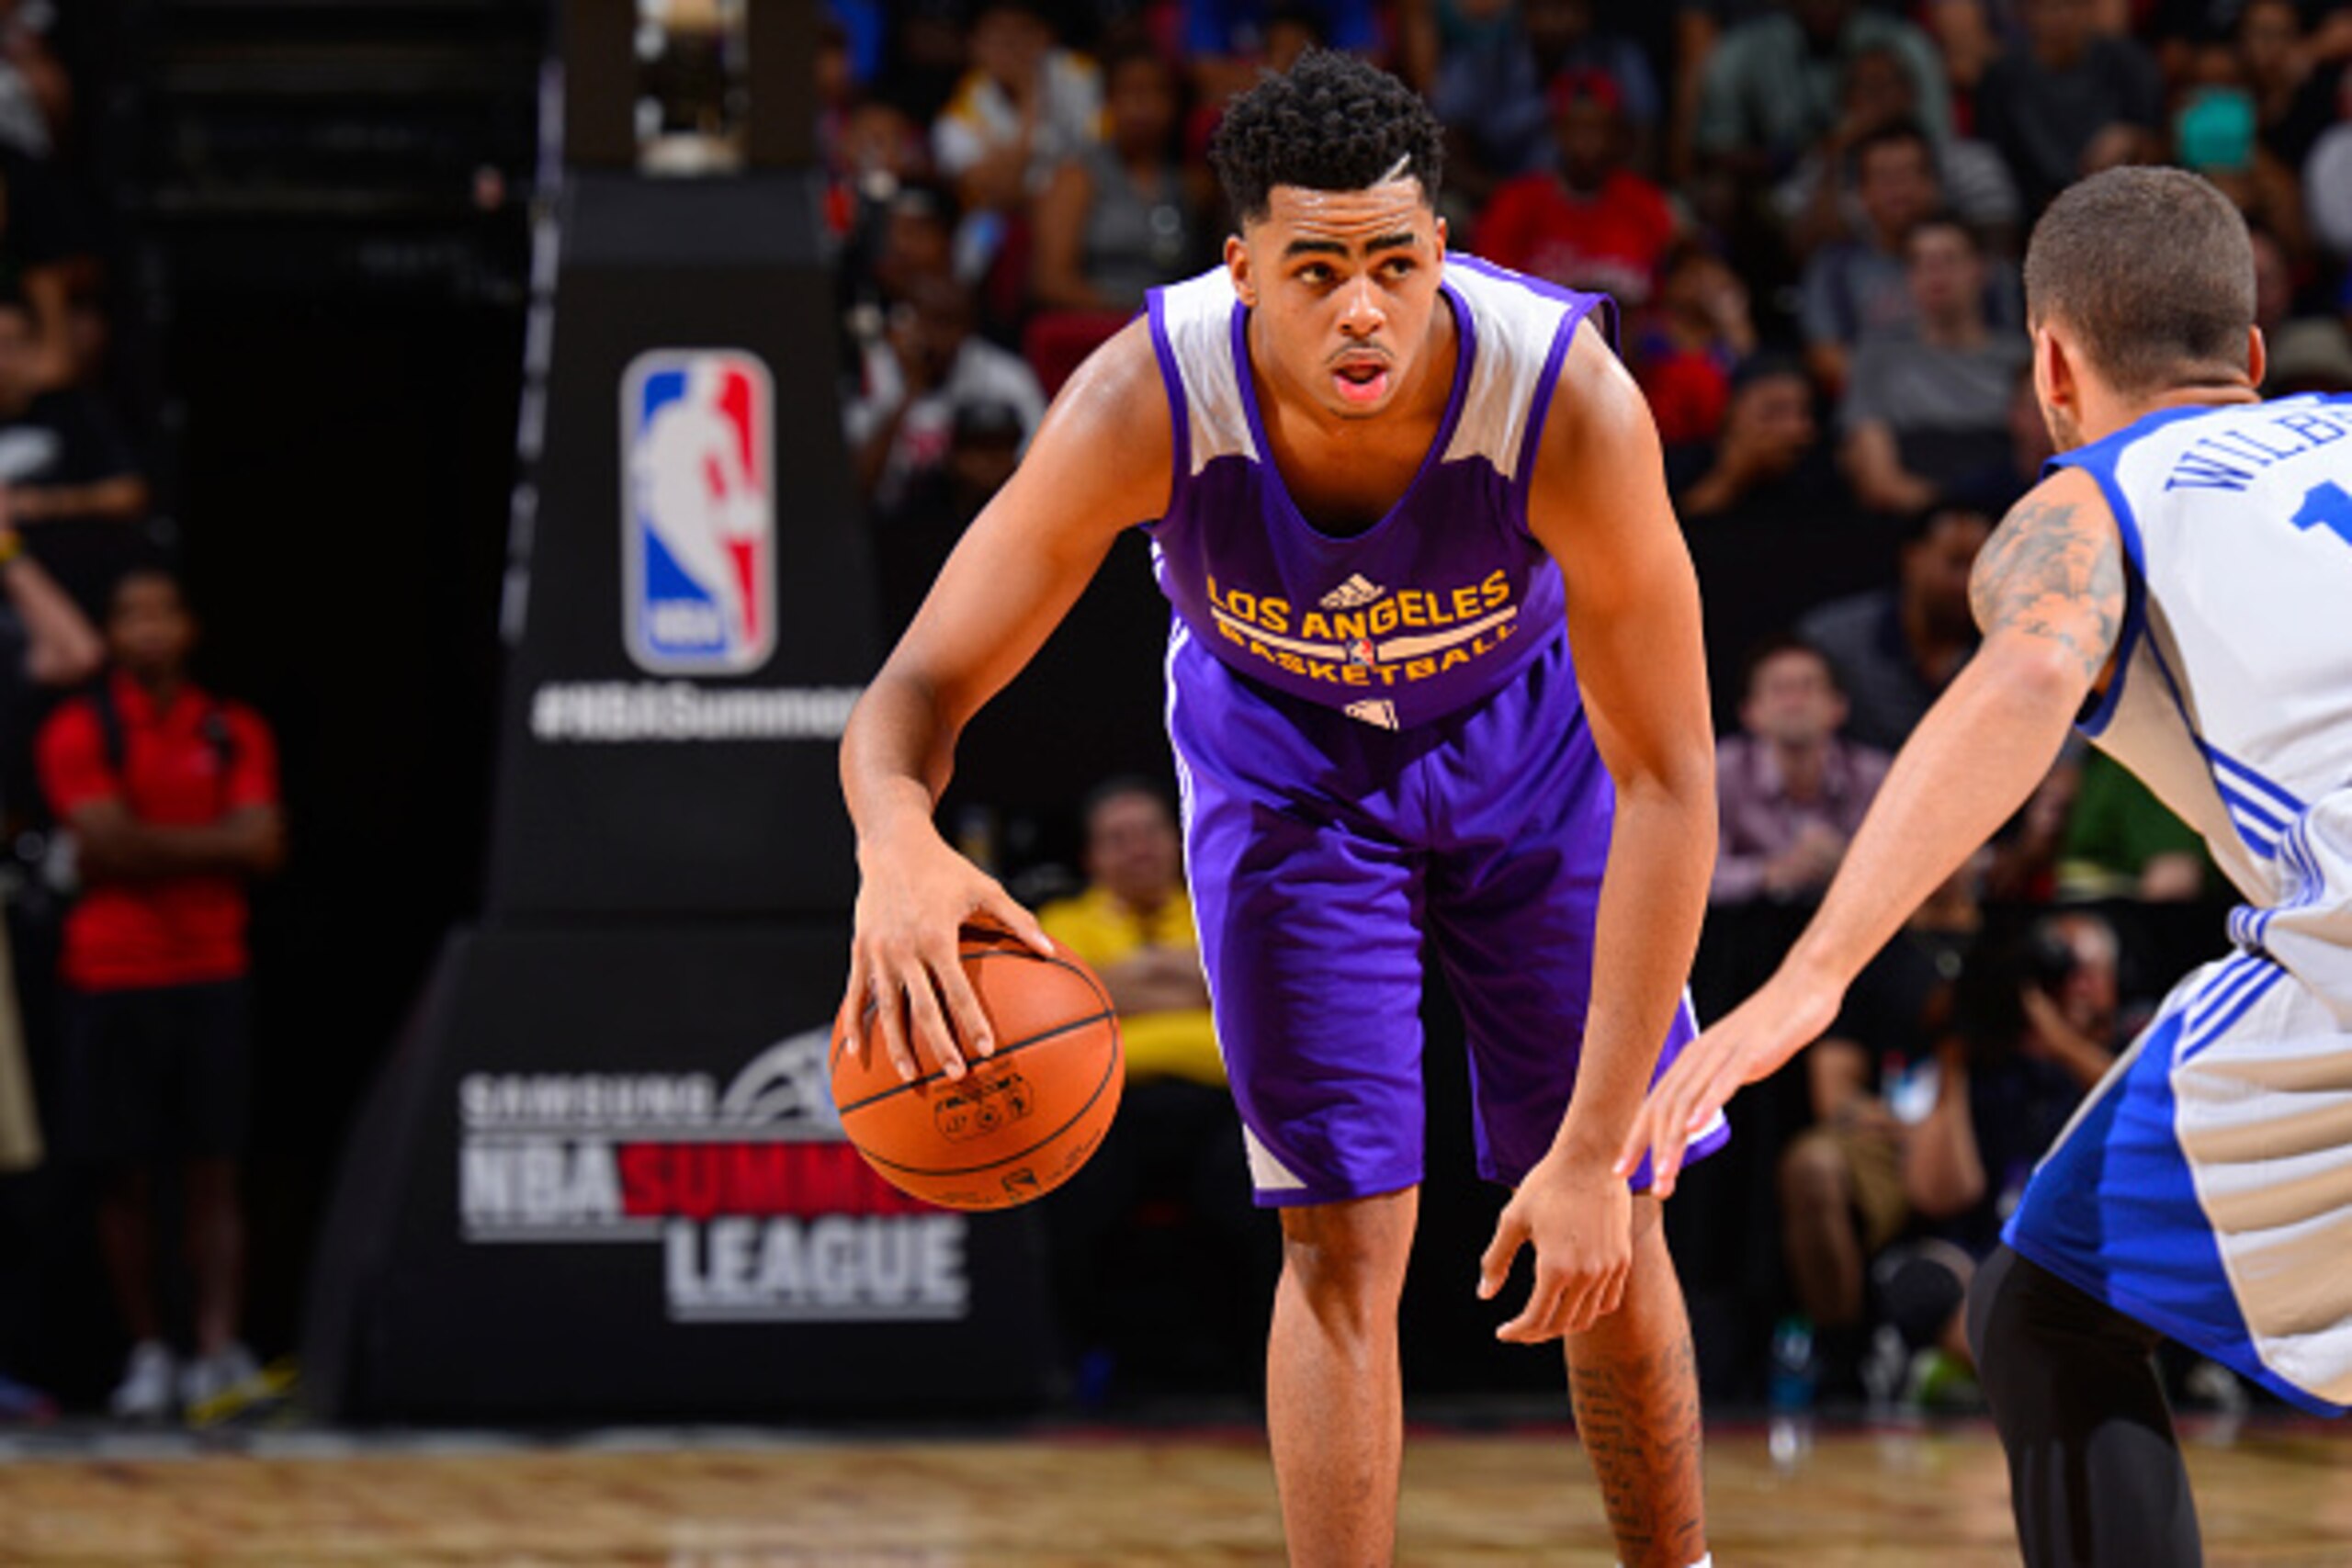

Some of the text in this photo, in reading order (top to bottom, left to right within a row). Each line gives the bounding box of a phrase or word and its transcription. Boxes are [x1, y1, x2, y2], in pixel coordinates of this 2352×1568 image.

[2164, 411, 2352, 492] WILB
[1206, 569, 1511, 640] LOS ANGELES
[1217, 621, 1518, 687] BASKETBALL
[460, 1073, 718, 1127] SAMSUNG
[460, 1141, 622, 1227] NBA
[621, 1140, 961, 1218] SUMM
[664, 1214, 970, 1312] LEAGUE
